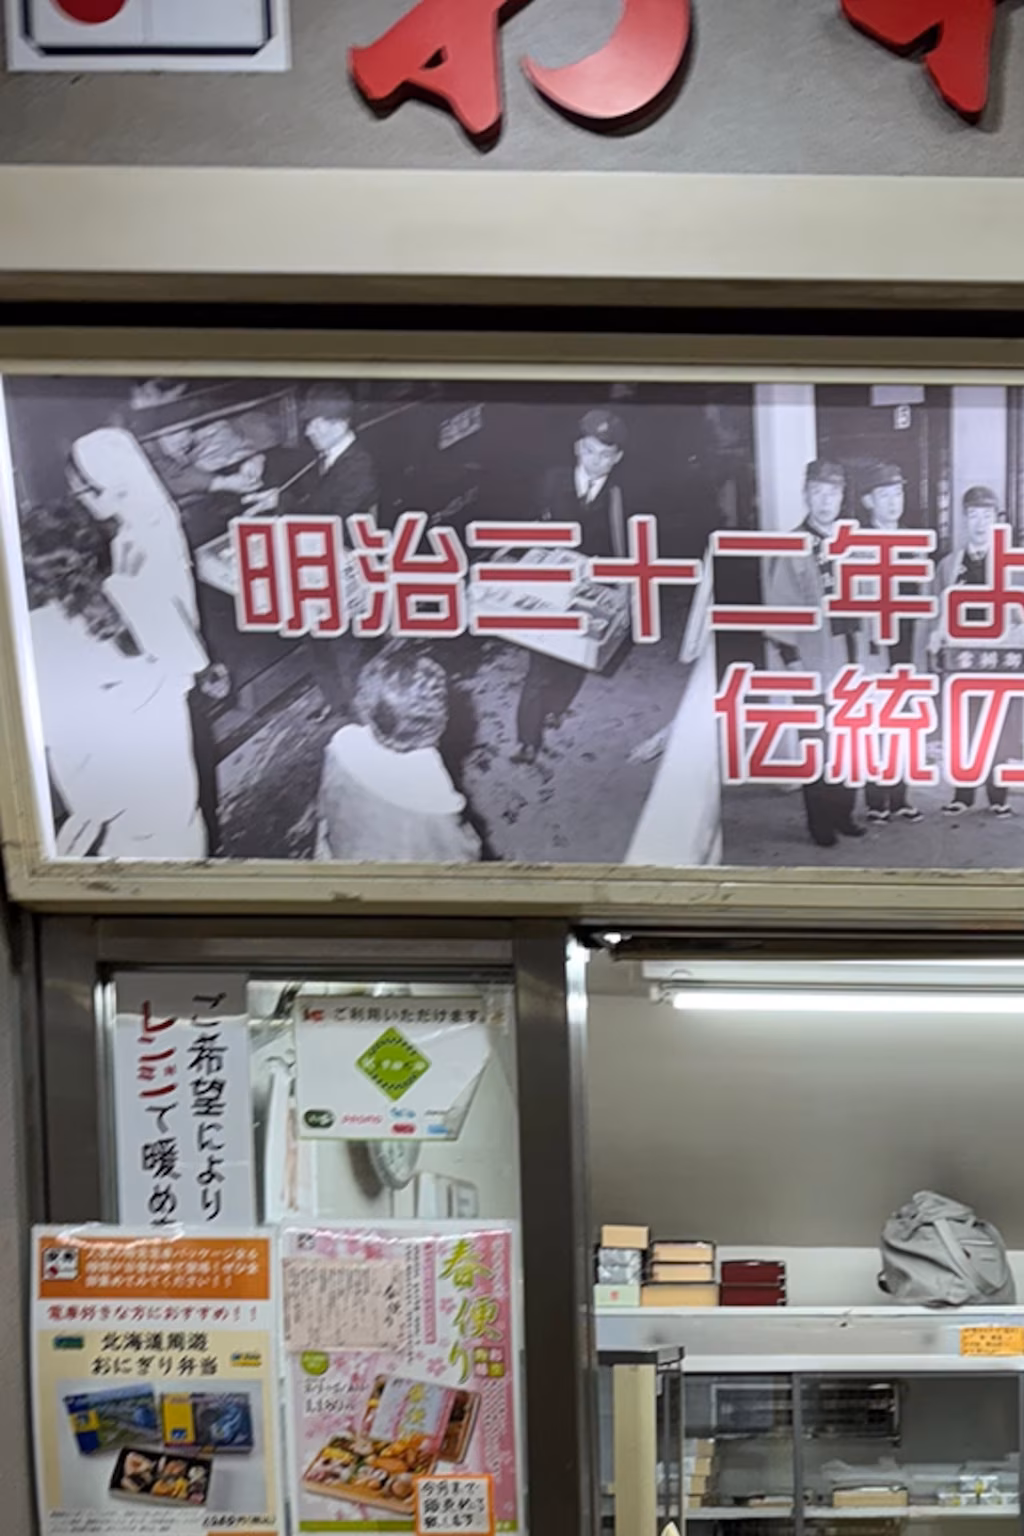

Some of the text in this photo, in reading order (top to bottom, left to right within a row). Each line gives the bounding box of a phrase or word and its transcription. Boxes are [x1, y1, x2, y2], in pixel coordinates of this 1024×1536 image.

[333, 1007, 487, 1024] ご利用いただけます。
[187, 992, 229, 1222] ご希望により
[101, 1331, 209, 1351] 北海道周遊
[91, 1355, 218, 1377] おにぎり弁当
